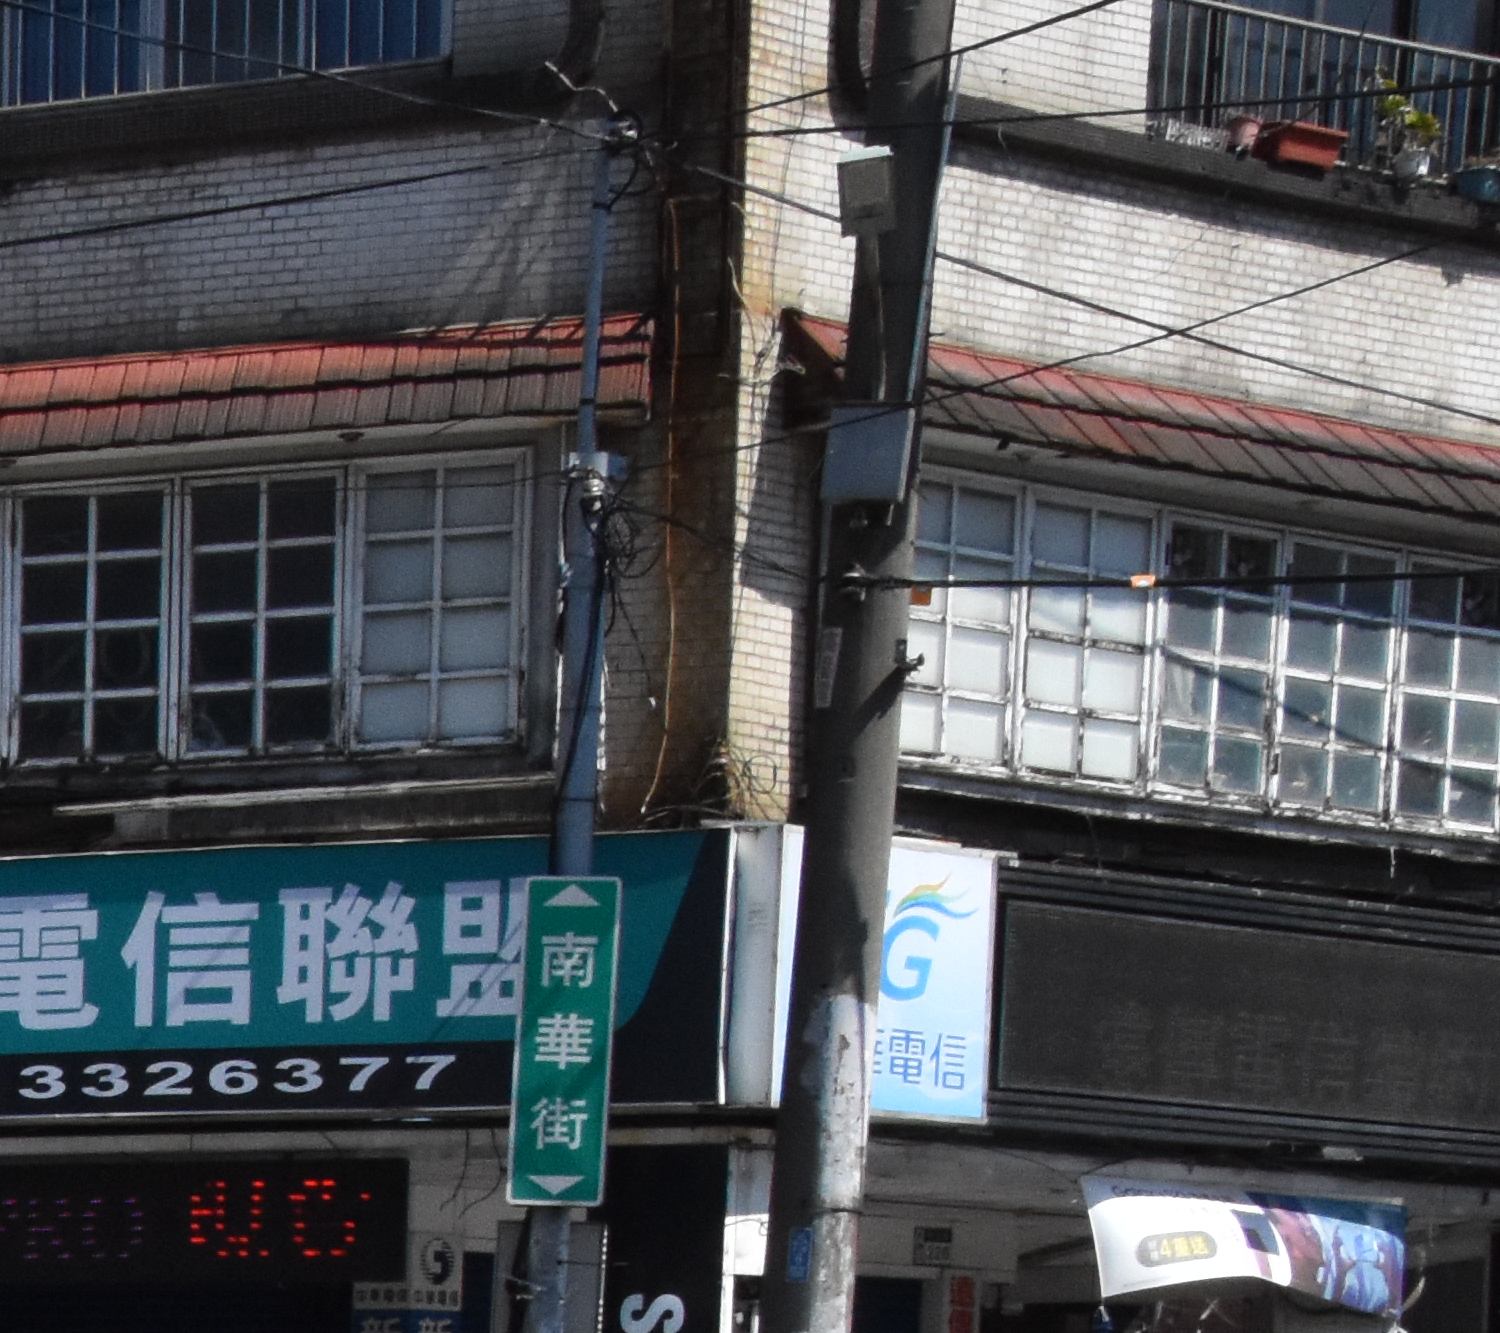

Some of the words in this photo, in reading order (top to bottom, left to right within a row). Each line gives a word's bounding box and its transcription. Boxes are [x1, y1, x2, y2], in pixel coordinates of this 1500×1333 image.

[879, 915, 940, 1002] G
[530, 932, 599, 1152] 南華街
[871, 1028, 967, 1091] 電信
